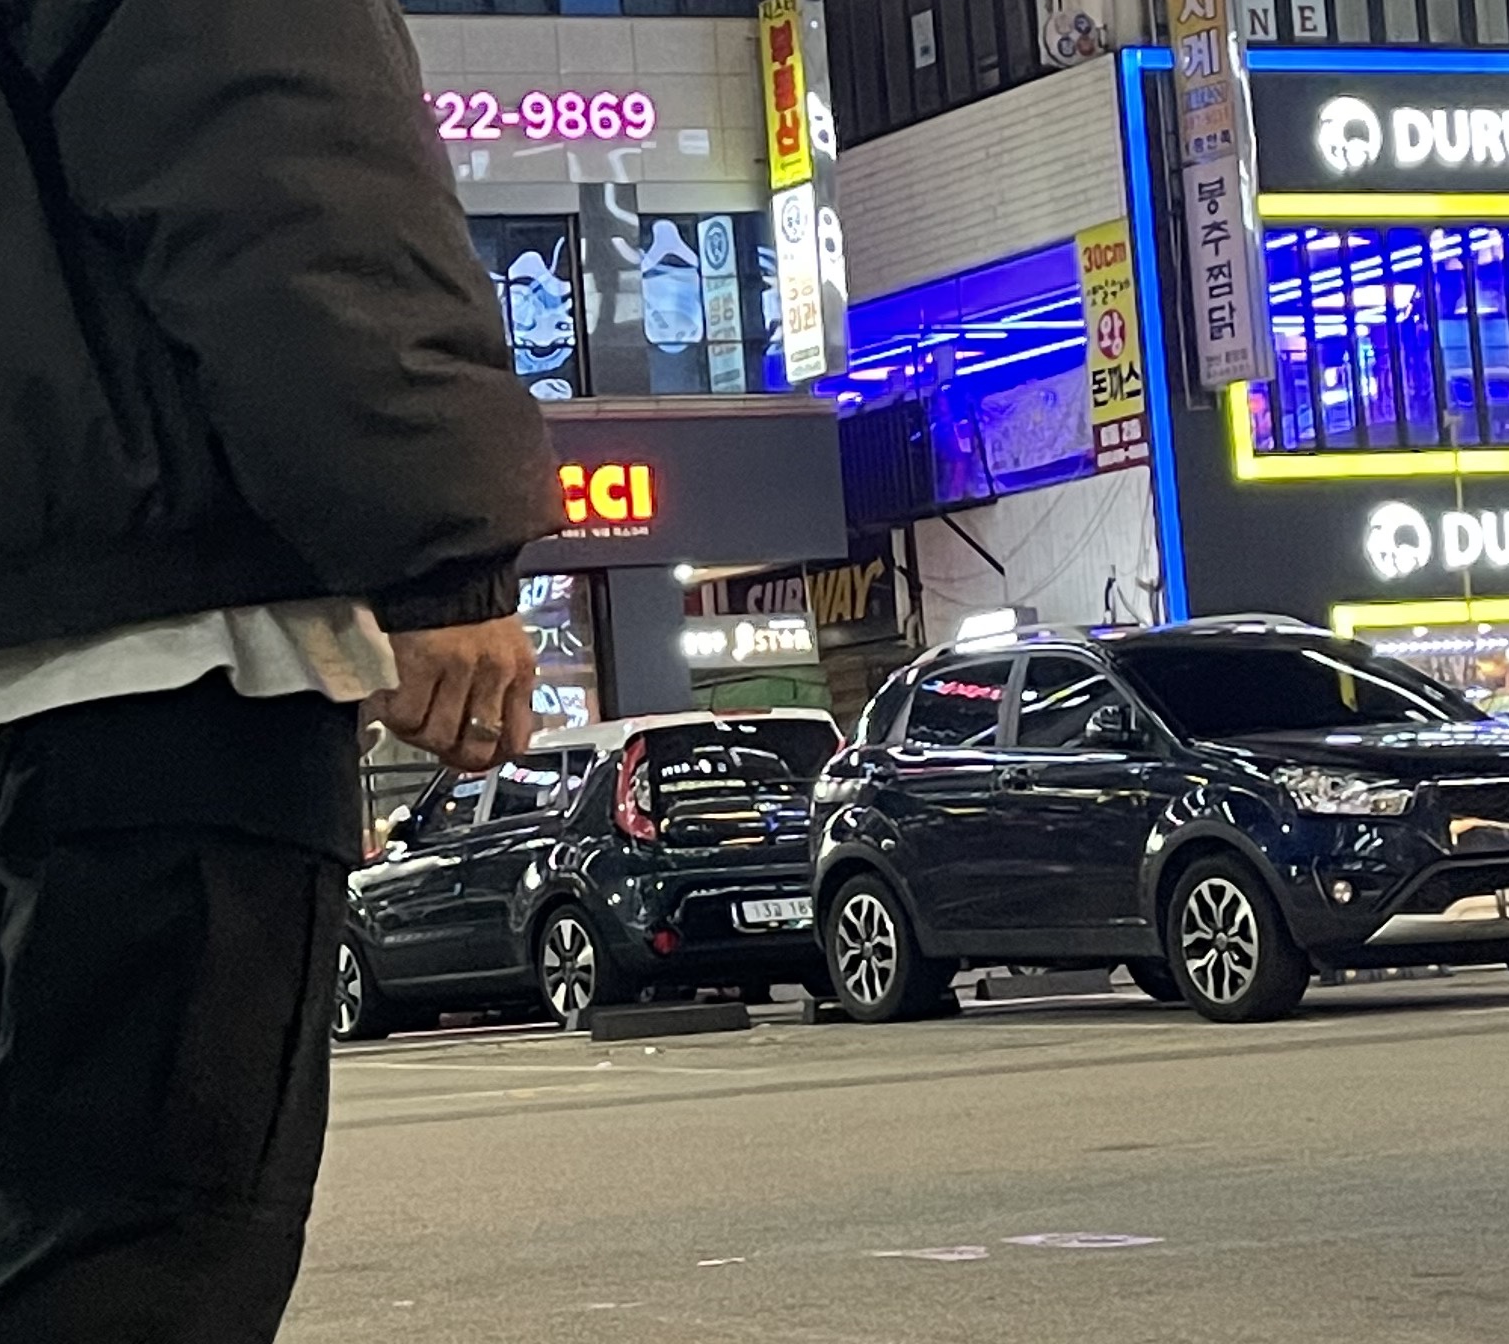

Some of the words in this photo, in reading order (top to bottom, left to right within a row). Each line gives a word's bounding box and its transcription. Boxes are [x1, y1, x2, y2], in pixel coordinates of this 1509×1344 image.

[422, 90, 657, 140] 22-9869
[1392, 108, 1509, 164] DUR
[1083, 240, 1128, 274] 30cm
[1197, 175, 1238, 342] 봉추찜닭
[1099, 310, 1125, 358] 왕
[747, 559, 885, 625] SUBWAY
